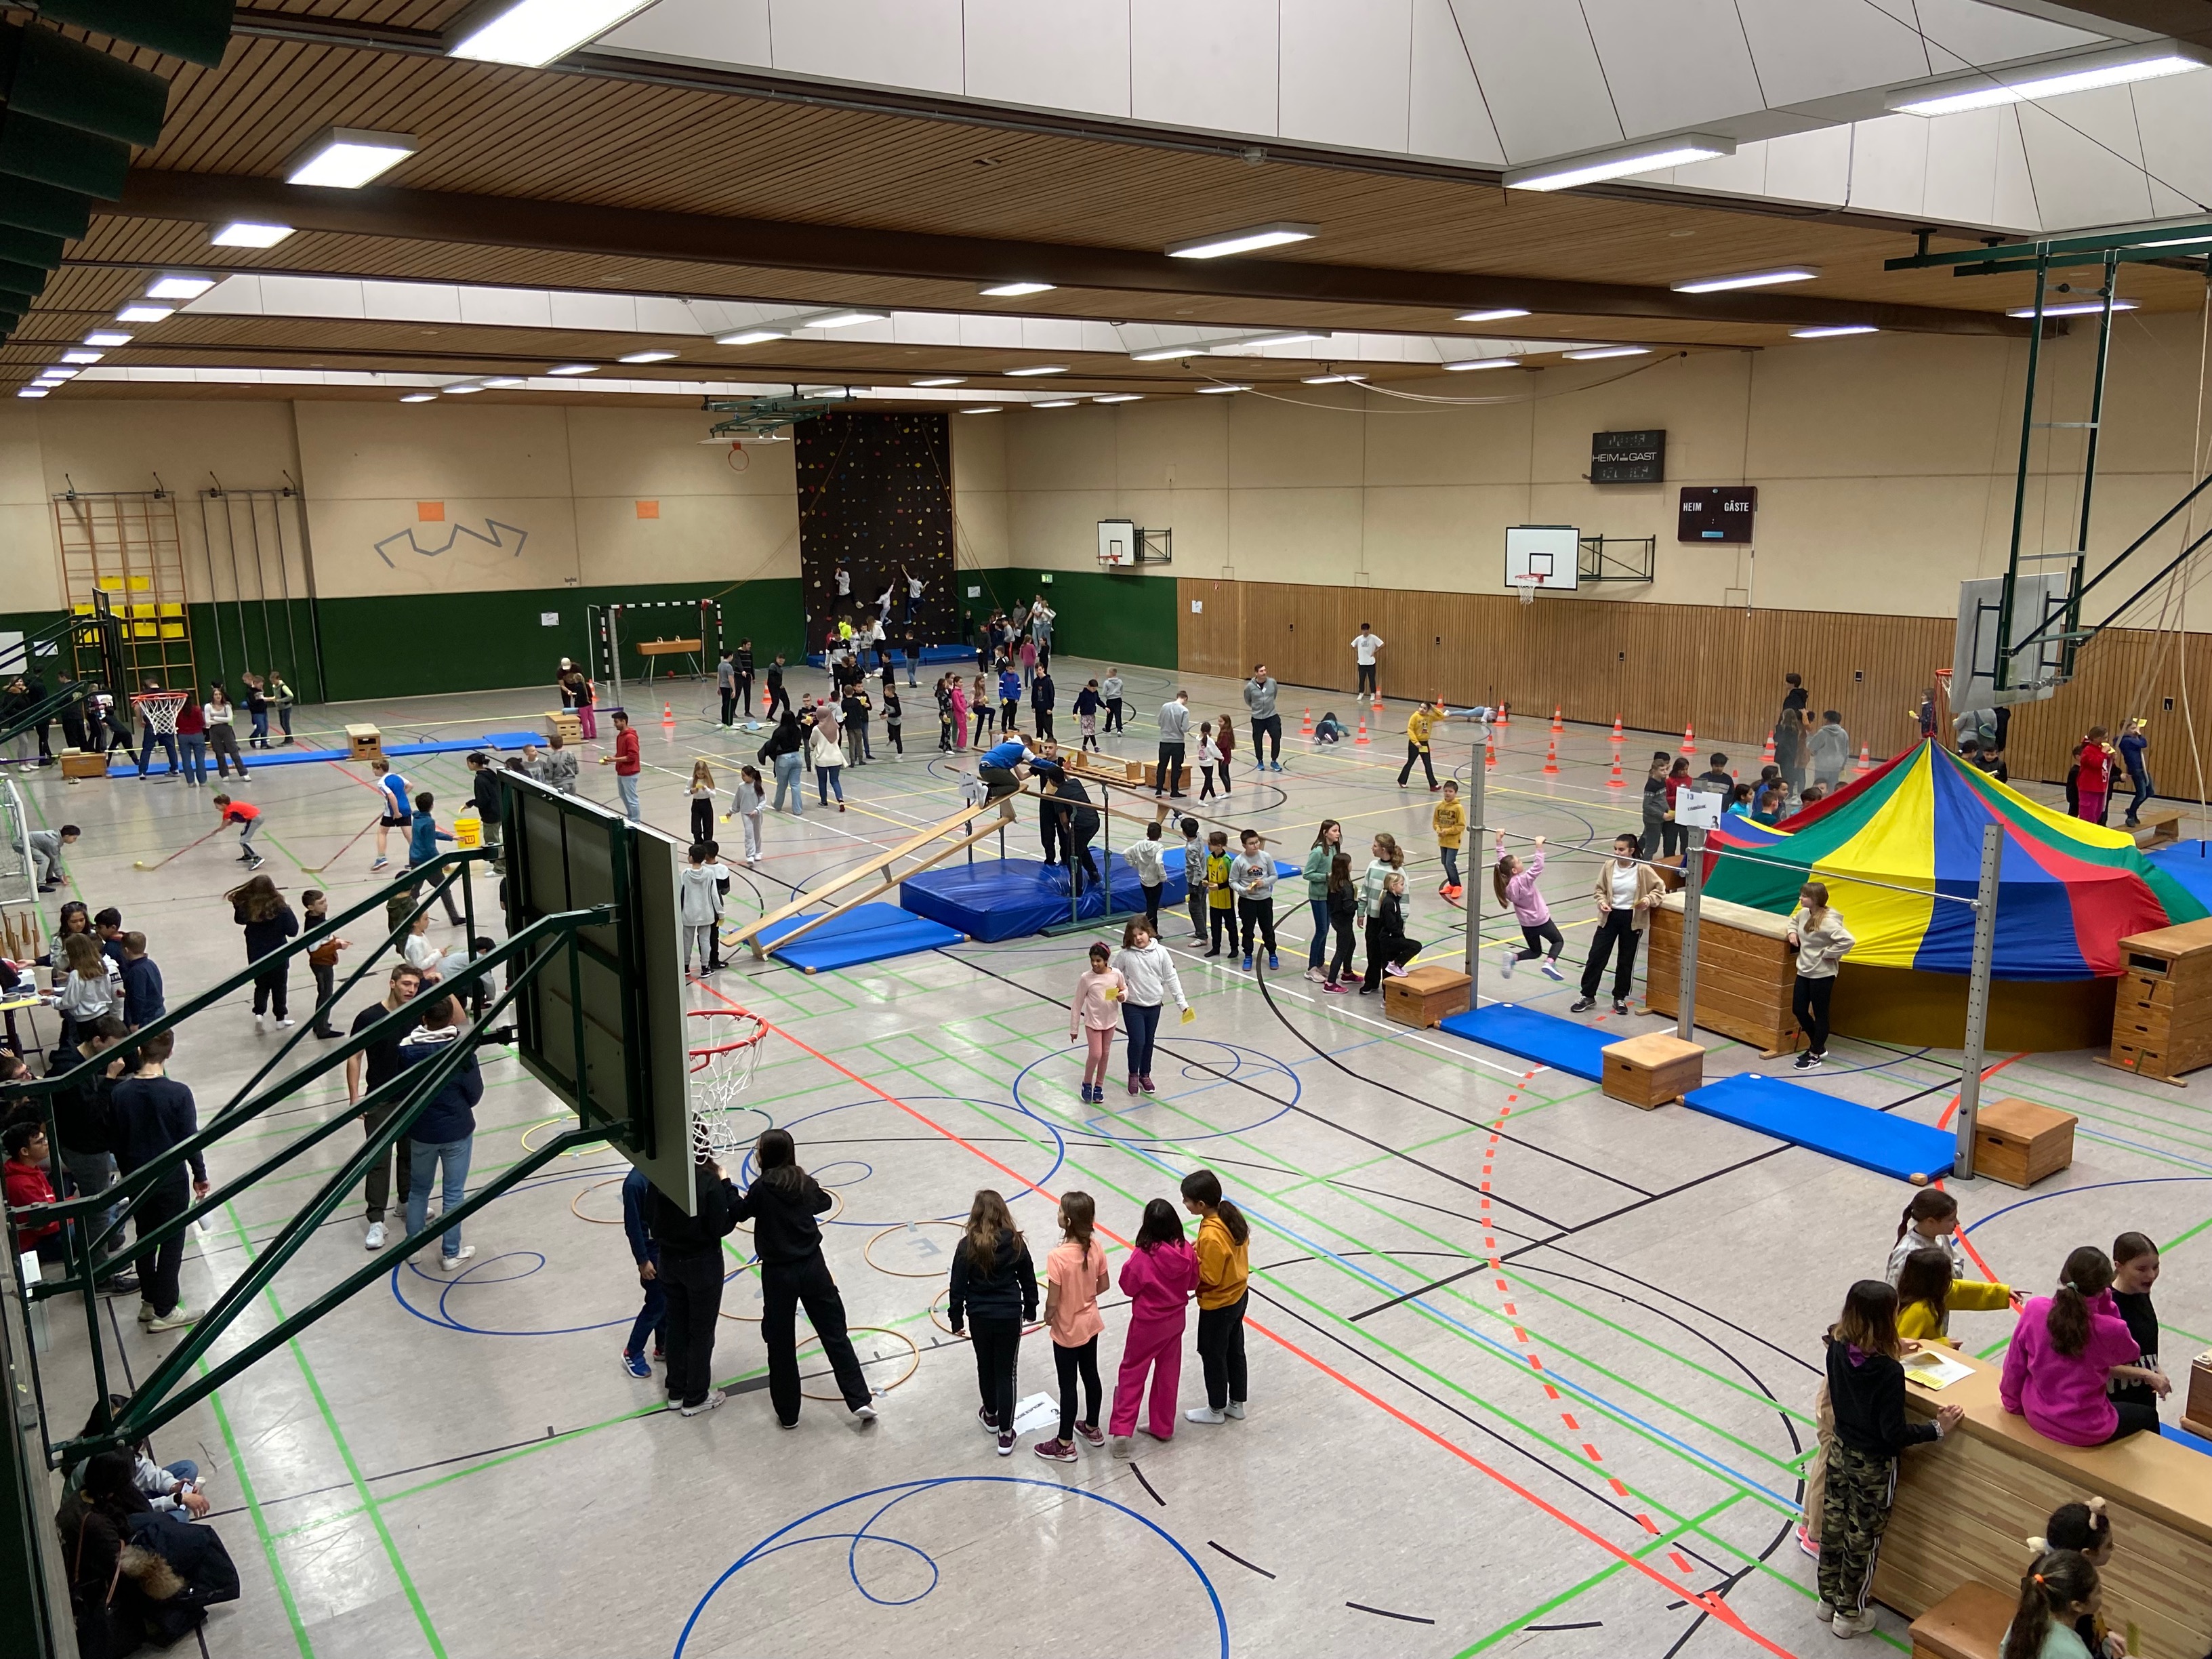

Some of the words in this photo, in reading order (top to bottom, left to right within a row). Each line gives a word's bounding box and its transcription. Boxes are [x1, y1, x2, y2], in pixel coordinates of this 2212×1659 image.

[1592, 453, 1619, 462] HEIM
[1629, 452, 1657, 461] GAST
[1683, 502, 1702, 512] HEIM
[1724, 499, 1750, 512] GÄSTE
